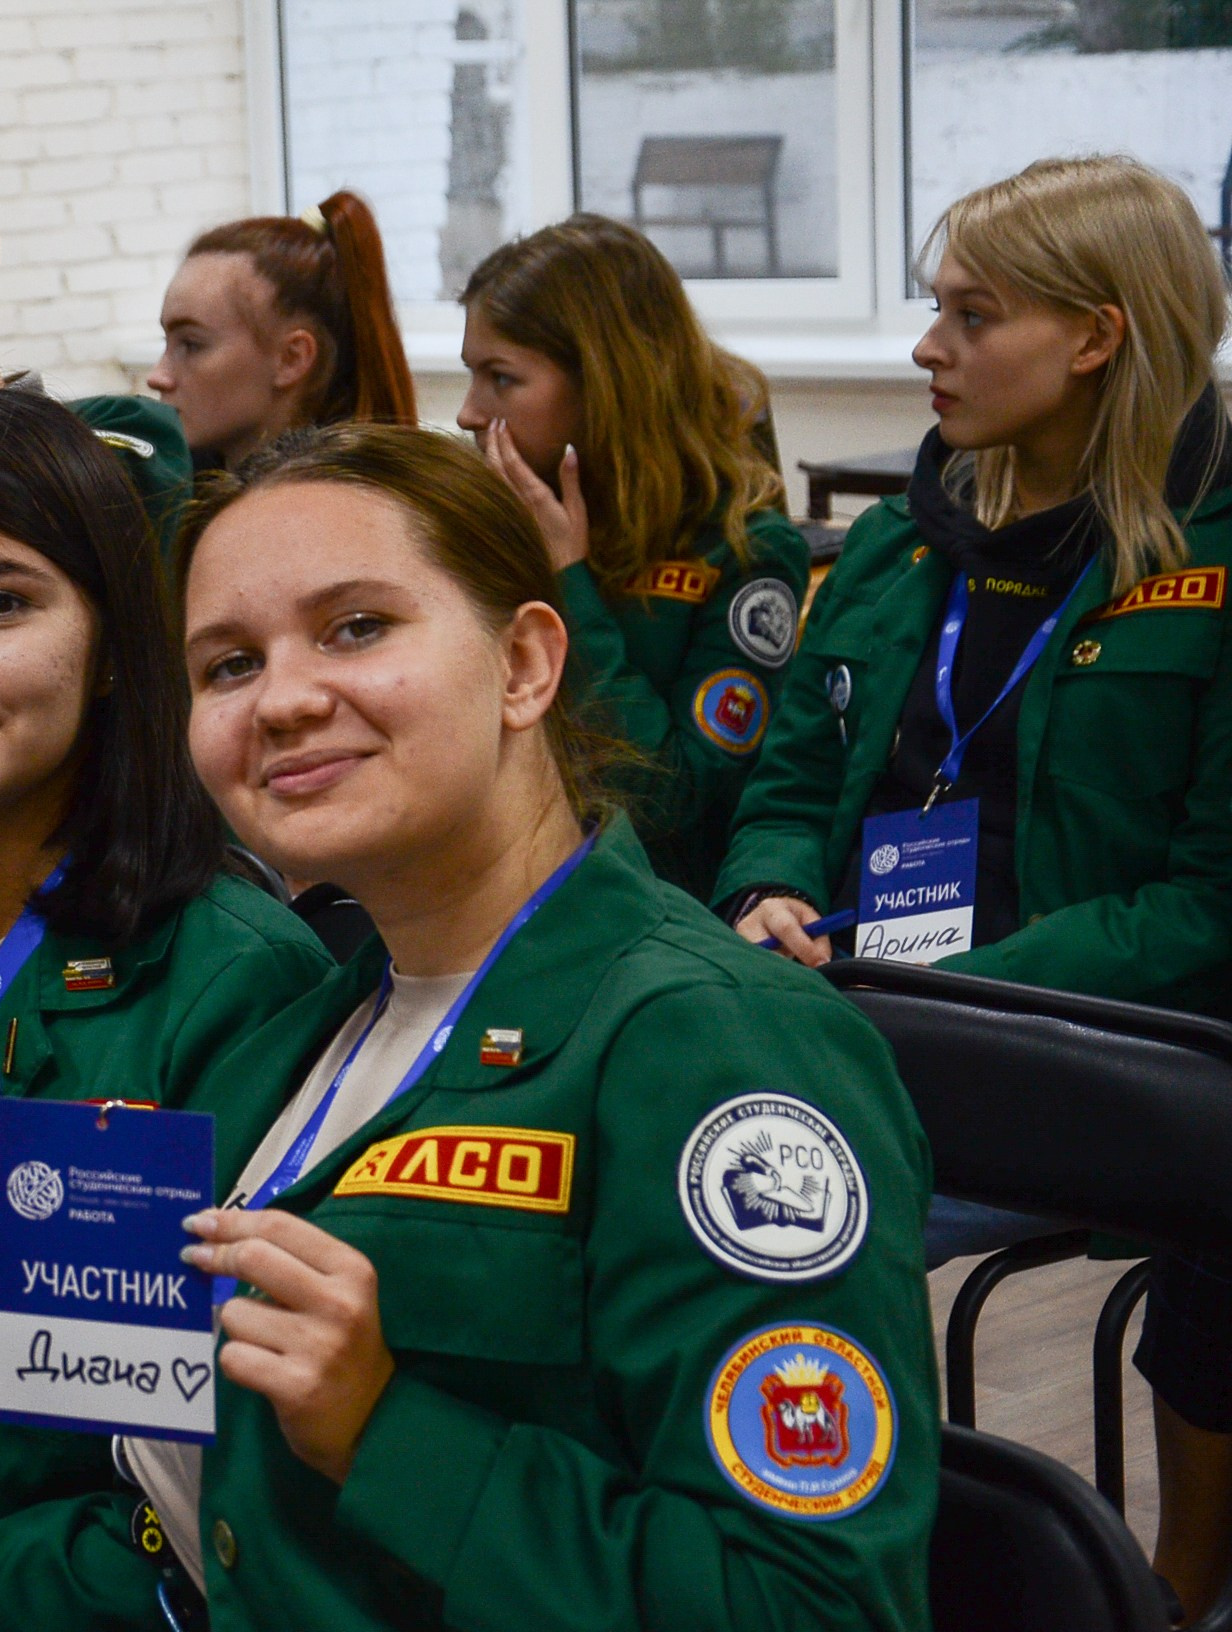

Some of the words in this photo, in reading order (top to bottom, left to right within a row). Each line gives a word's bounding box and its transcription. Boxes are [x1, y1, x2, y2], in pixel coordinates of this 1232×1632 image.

[1122, 574, 1208, 608] ЛСО
[873, 880, 962, 913] УЧАСТНИК
[859, 924, 965, 960] Арина
[397, 1137, 543, 1195] ЛСО
[778, 1143, 824, 1171] РСО
[68, 1207, 117, 1225] РАБОТА
[20, 1258, 189, 1310] УЧАСТНИК
[15, 1329, 161, 1395] Диана
[715, 1328, 804, 1414] ЧЕЛЯБИНСКИЙ
